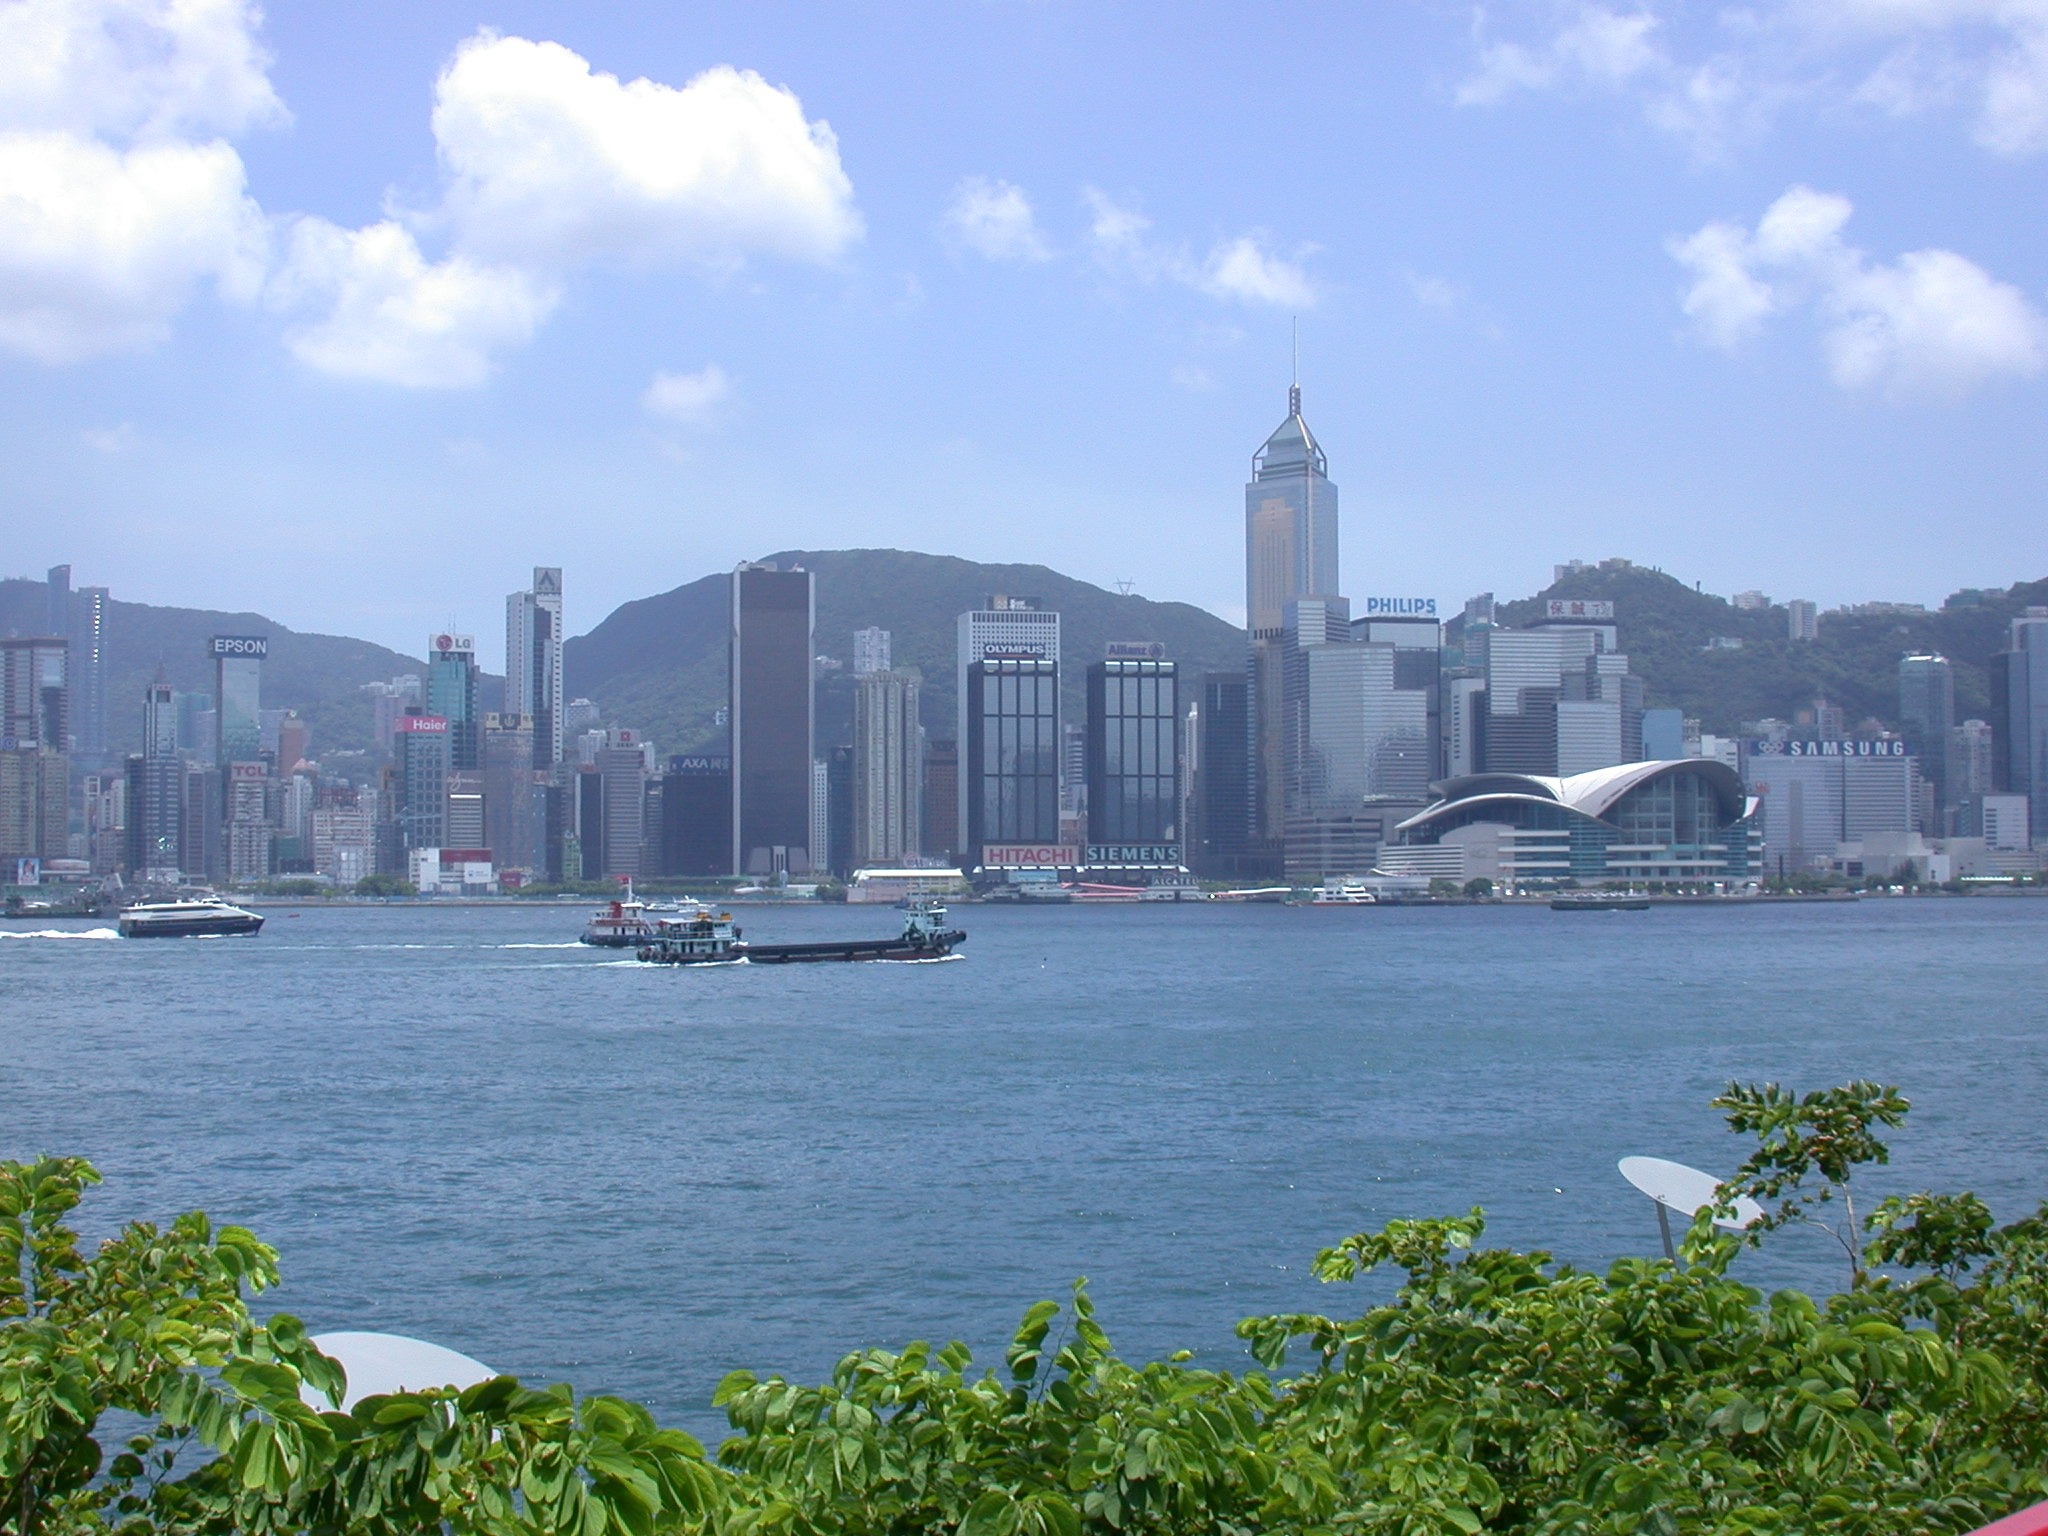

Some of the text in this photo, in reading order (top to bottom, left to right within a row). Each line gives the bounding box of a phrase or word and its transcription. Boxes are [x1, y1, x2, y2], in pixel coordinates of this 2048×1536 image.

[1367, 598, 1436, 613] PHILIPS
[215, 639, 266, 653] EPSON
[455, 639, 471, 649] LG
[985, 645, 1045, 654] OLYMPUS
[1108, 644, 1147, 656] Allianz
[413, 719, 447, 730] Haier
[1791, 741, 1904, 756] SAMSUNG
[683, 758, 708, 768] AXA
[233, 766, 266, 777] TCL
[989, 848, 1073, 863] HITACHI
[1088, 847, 1178, 861] SIEMENS
[1154, 878, 1197, 886] ALCATEL
